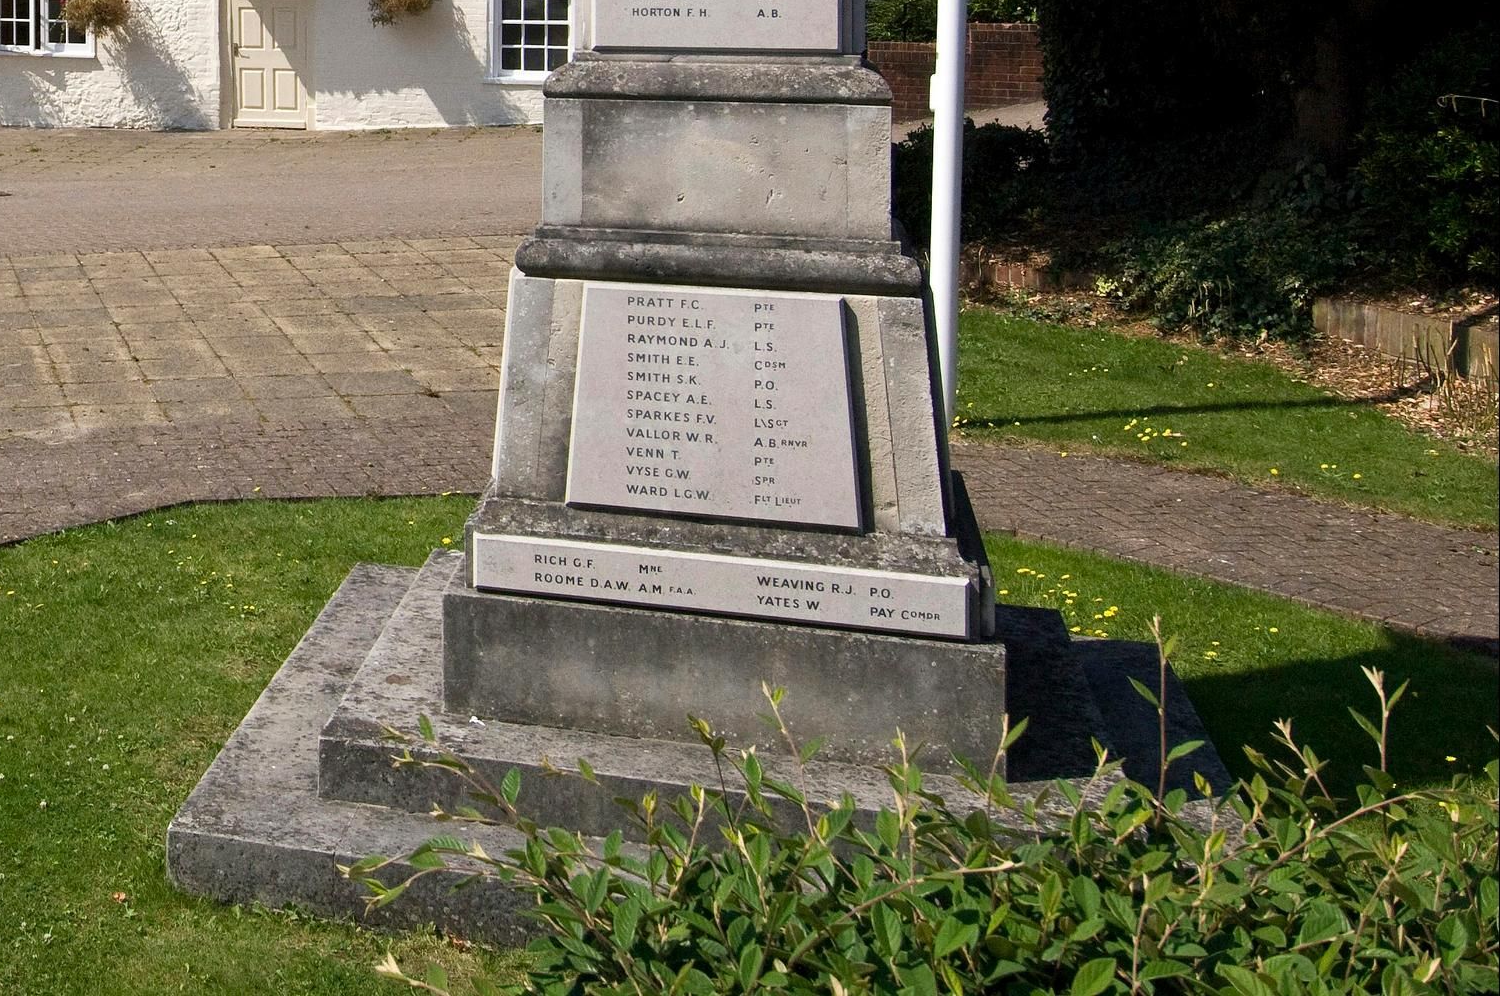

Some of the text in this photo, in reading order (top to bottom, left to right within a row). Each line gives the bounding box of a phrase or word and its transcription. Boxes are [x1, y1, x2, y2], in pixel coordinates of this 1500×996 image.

[632, 8, 681, 16] HORTON
[627, 297, 674, 307] PRATT
[627, 315, 676, 326] PURDY
[627, 334, 698, 347] RAYMOND
[627, 353, 670, 364] SMITH
[627, 372, 670, 383] SMITH
[627, 390, 680, 402] SPACEY
[627, 409, 690, 422] SPARKES
[626, 428, 681, 440] VALLOR
[626, 447, 664, 458] VENN
[671, 450, 681, 459] T.
[626, 466, 660, 477] VYSE
[626, 484, 668, 496] WARD
[534, 555, 567, 566] RICH
[534, 573, 584, 586] ROOME
[757, 576, 825, 591] WEAVING
[757, 596, 800, 608] YATES
[806, 601, 822, 610] W.
[870, 607, 895, 617] PAY
